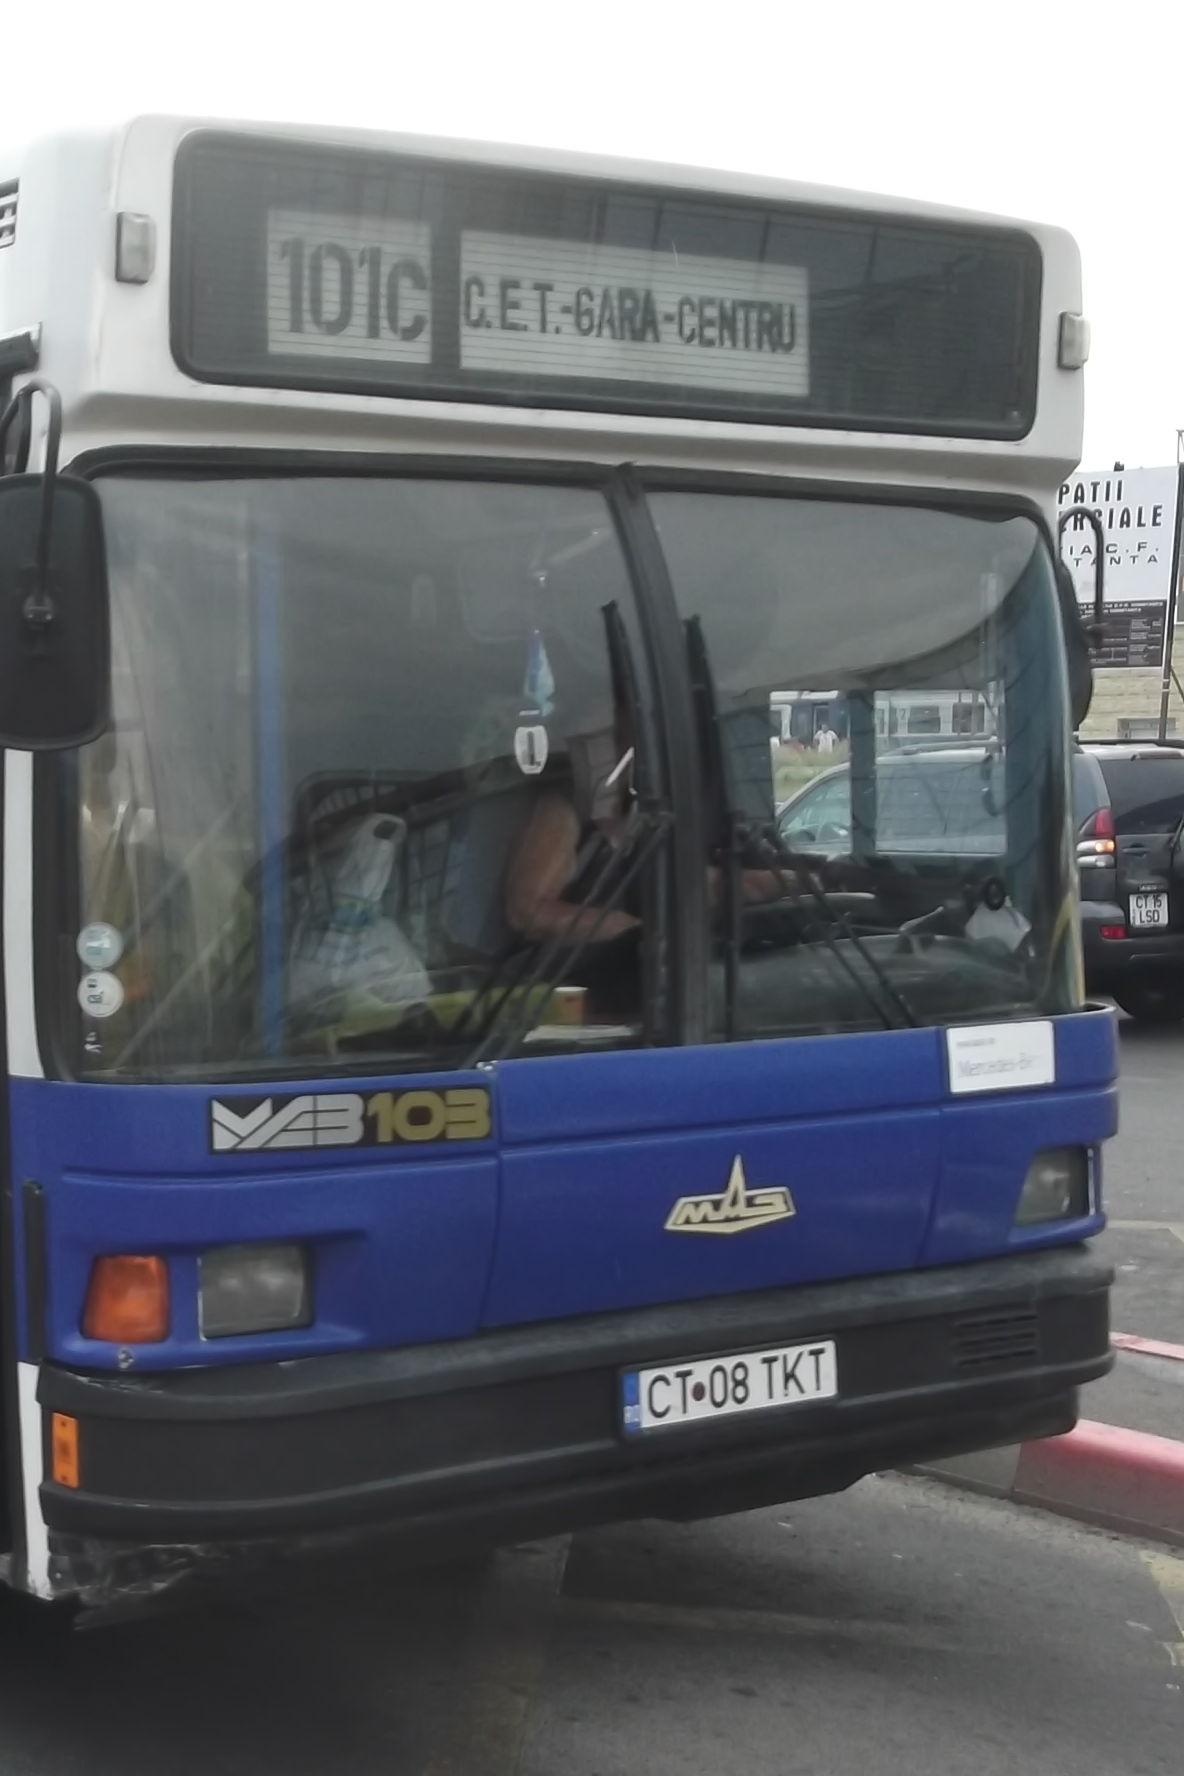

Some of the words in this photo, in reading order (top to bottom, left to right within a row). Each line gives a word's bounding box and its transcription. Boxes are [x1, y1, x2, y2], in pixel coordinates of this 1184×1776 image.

[281, 236, 428, 342] 101C
[1136, 895, 1149, 909] CT
[367, 1088, 491, 1143] 103
[648, 1369, 693, 1418] CT
[709, 1361, 750, 1409] 08
[761, 1347, 826, 1400] TKT
